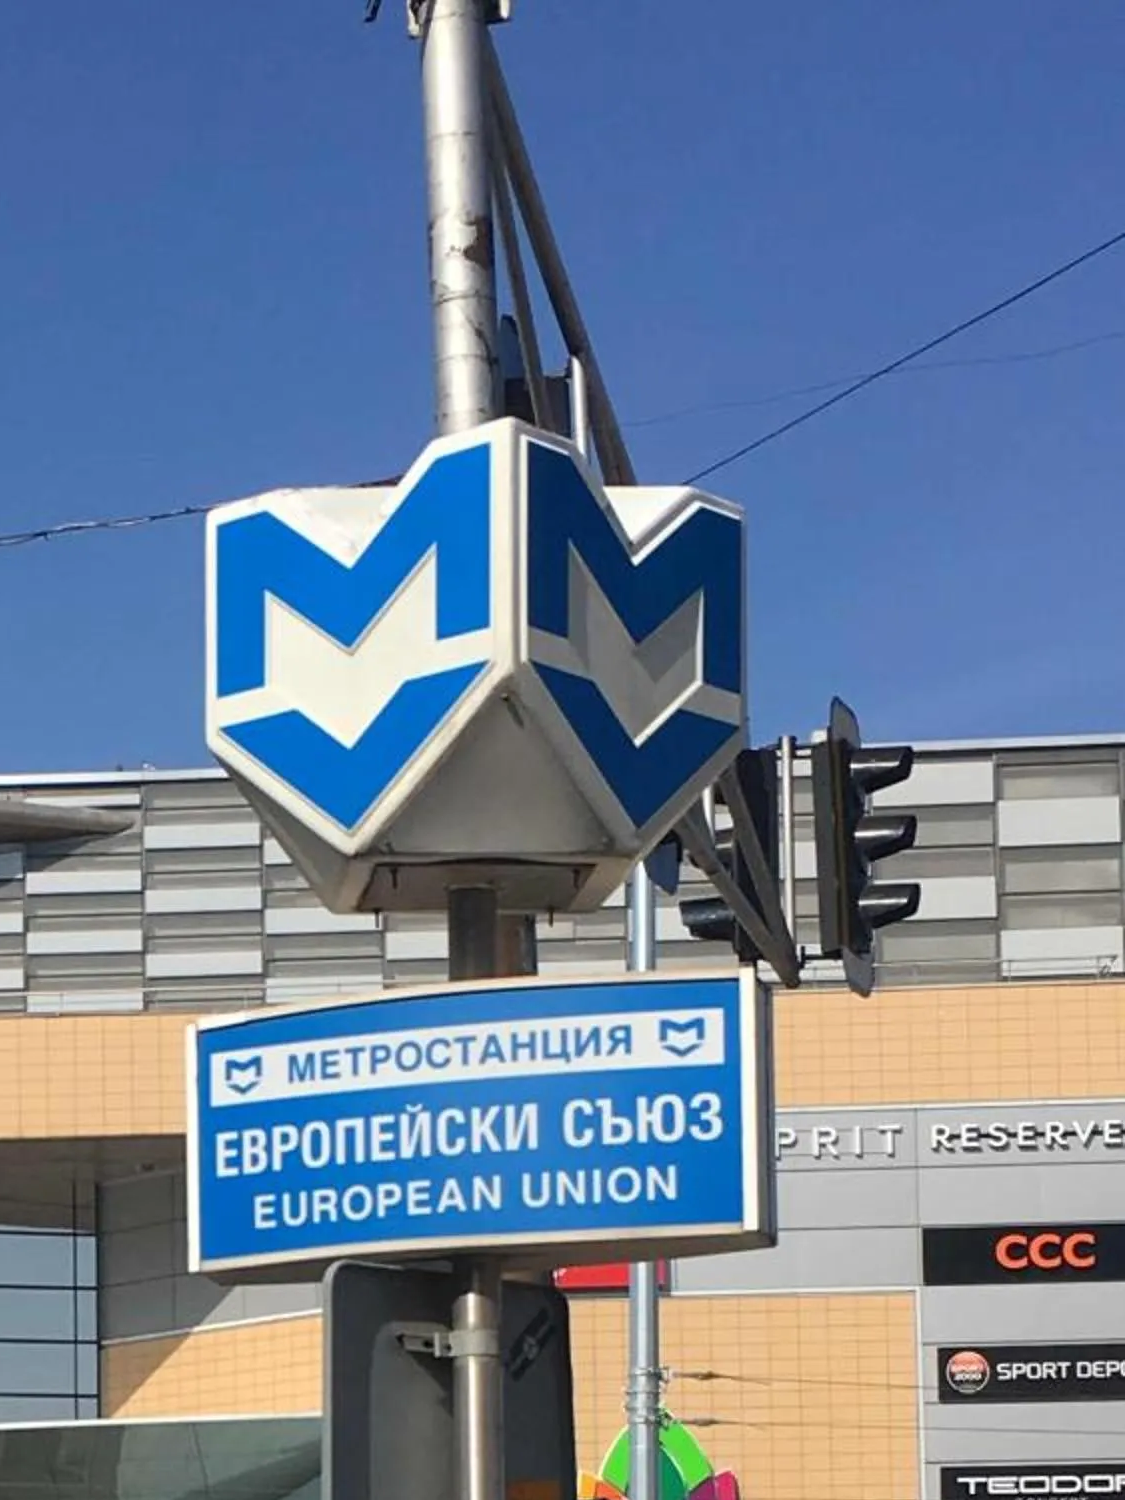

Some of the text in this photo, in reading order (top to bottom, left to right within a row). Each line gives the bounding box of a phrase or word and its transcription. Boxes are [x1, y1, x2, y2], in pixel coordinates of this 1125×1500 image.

[287, 1024, 634, 1085] МЕТРОСТАНЦИЯ
[215, 1091, 725, 1179] ЕВРОПЕЙСКИ СЪЮЗ
[252, 1164, 678, 1230] EUROPEAN UNION
[995, 1233, 1097, 1270] CCC
[996, 1362, 1071, 1381] SPORT
